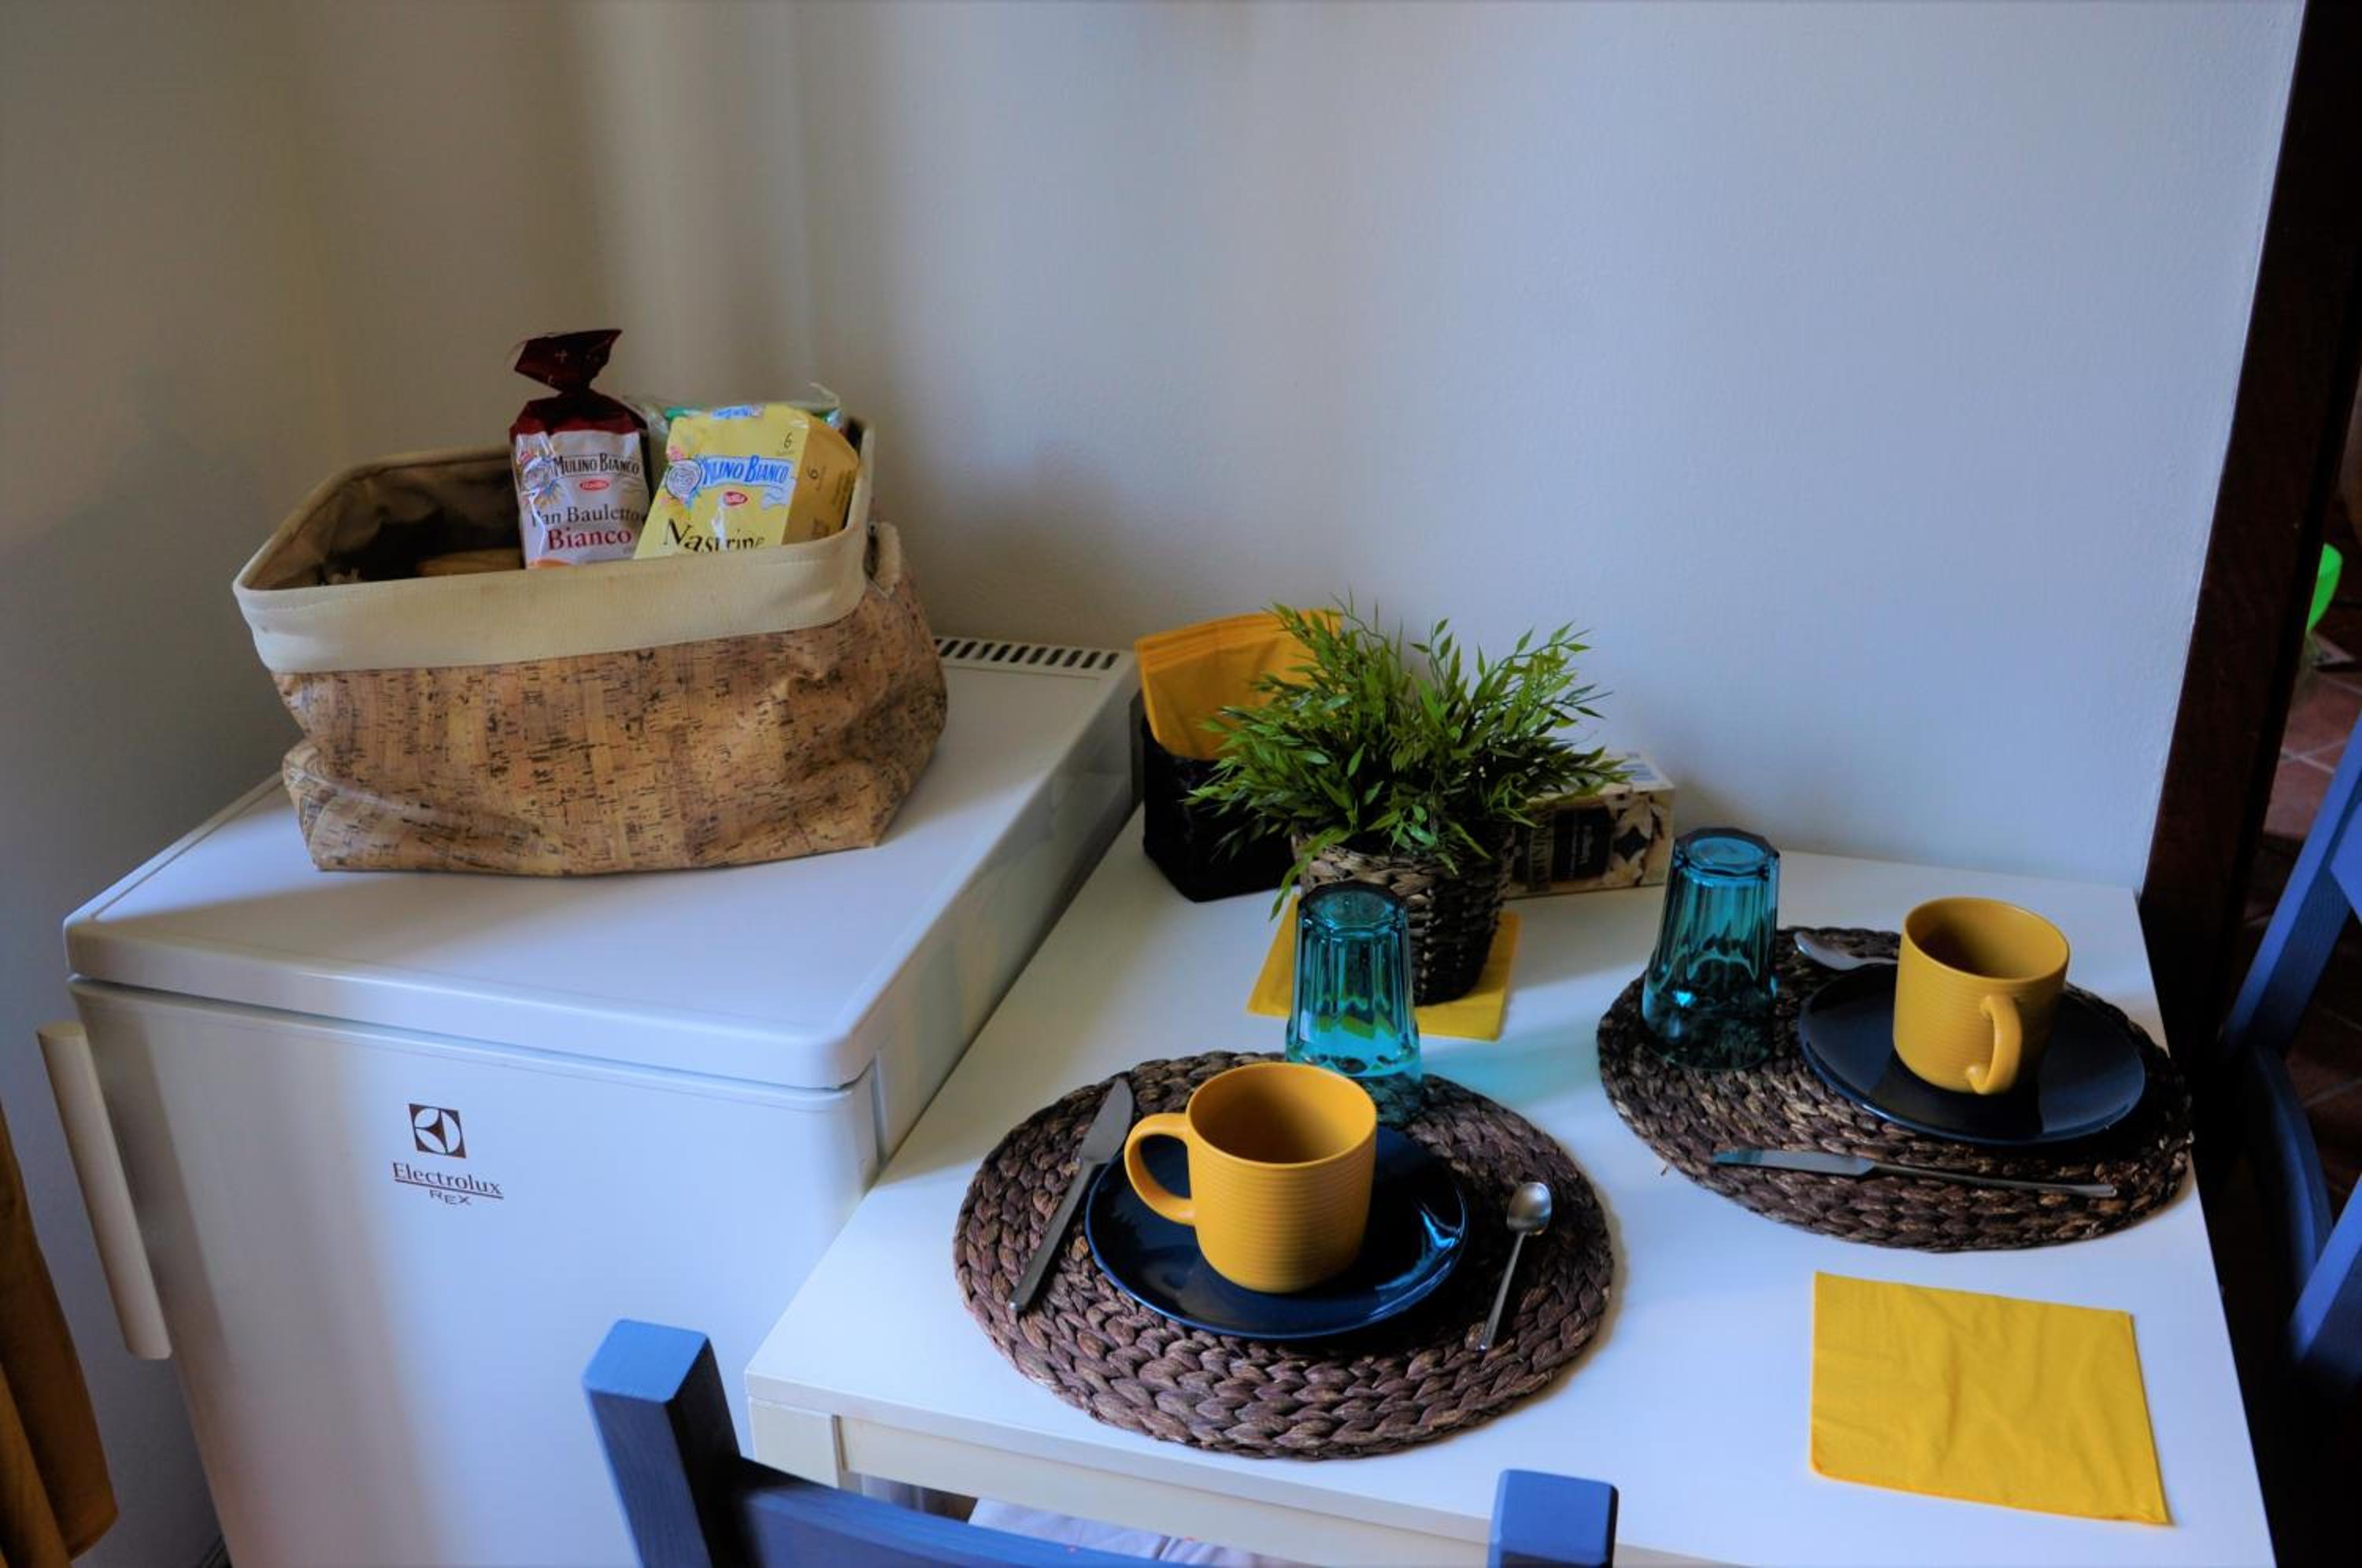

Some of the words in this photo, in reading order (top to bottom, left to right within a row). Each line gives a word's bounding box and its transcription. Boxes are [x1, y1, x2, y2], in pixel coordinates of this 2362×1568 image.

[553, 456, 598, 478] MULINO
[598, 453, 640, 475] BIANCO
[547, 527, 632, 551] Bianco
[393, 1161, 503, 1195] Electrolux
[428, 1189, 472, 1206] REX
